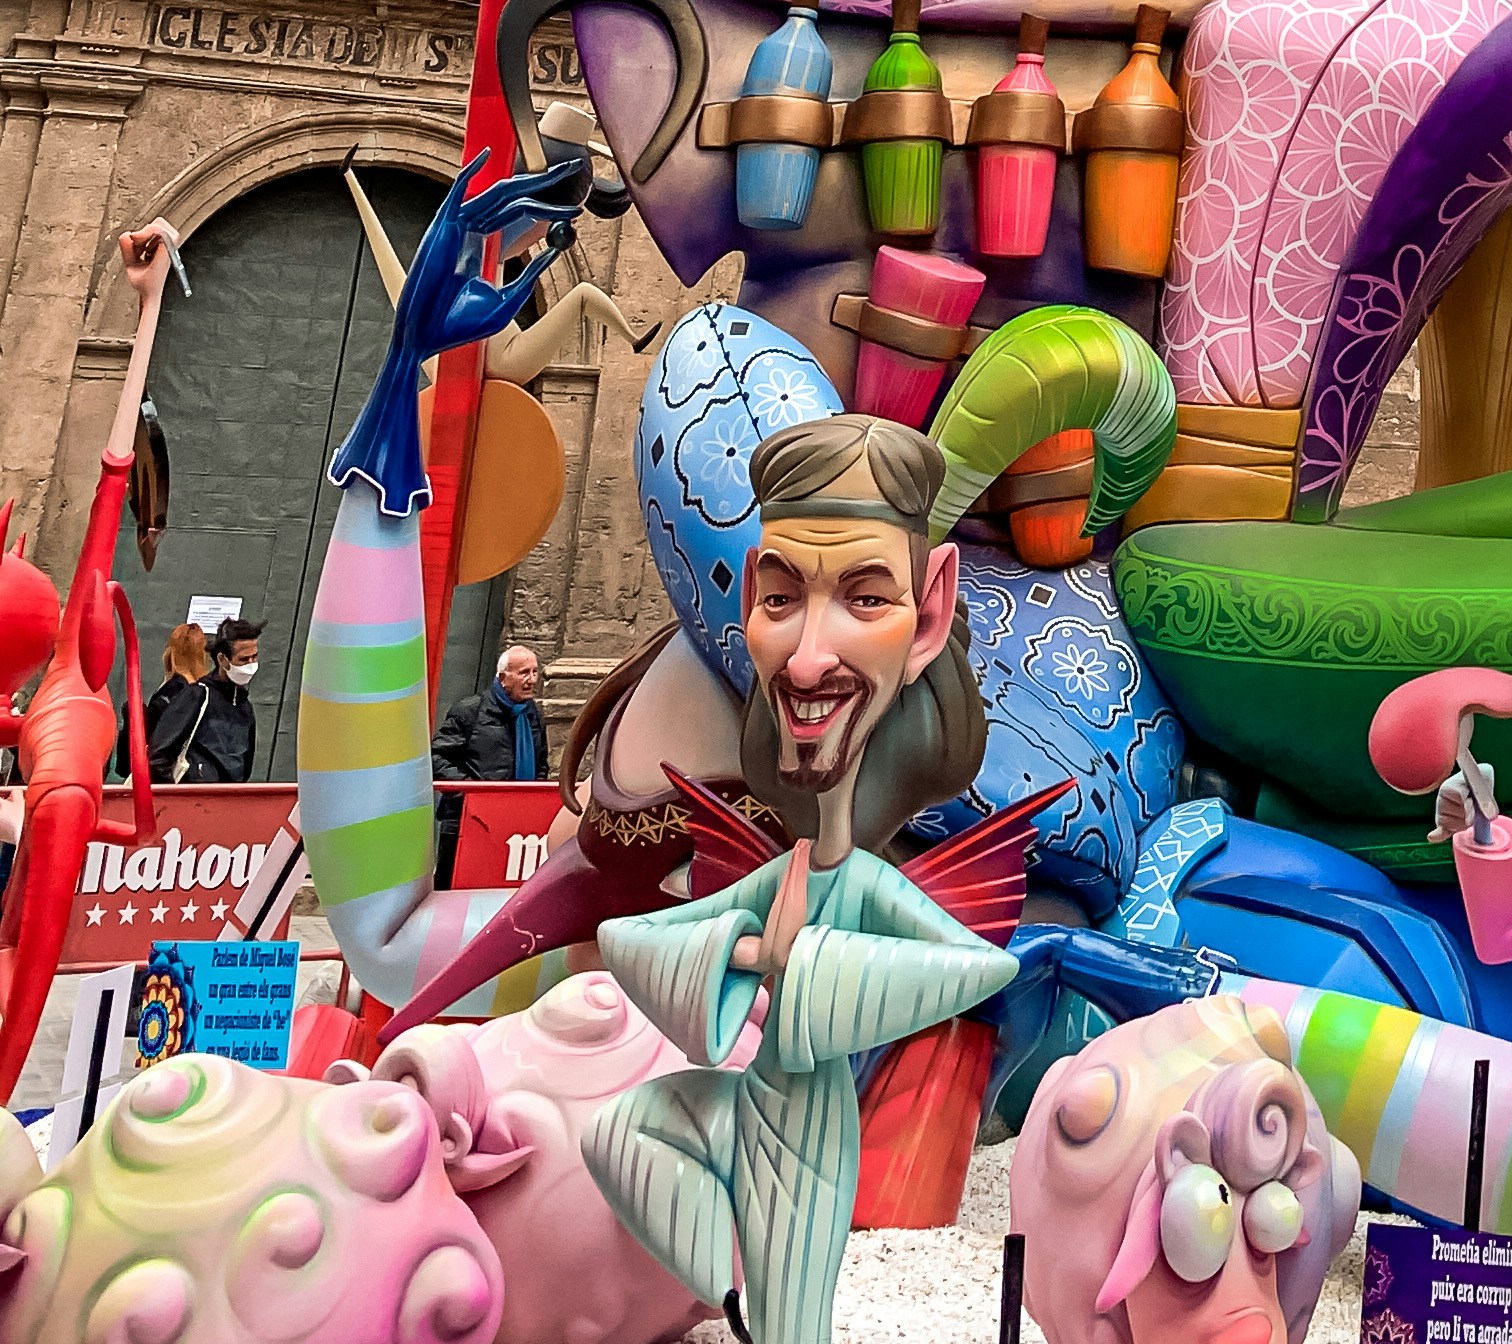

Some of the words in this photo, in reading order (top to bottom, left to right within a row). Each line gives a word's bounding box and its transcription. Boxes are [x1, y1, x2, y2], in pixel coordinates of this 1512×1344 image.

[1430, 1274, 1456, 1307] puix
[1456, 1283, 1475, 1304] era
[1425, 1319, 1452, 1344] pero
[1452, 1315, 1462, 1342] li
[1463, 1322, 1476, 1344] va
